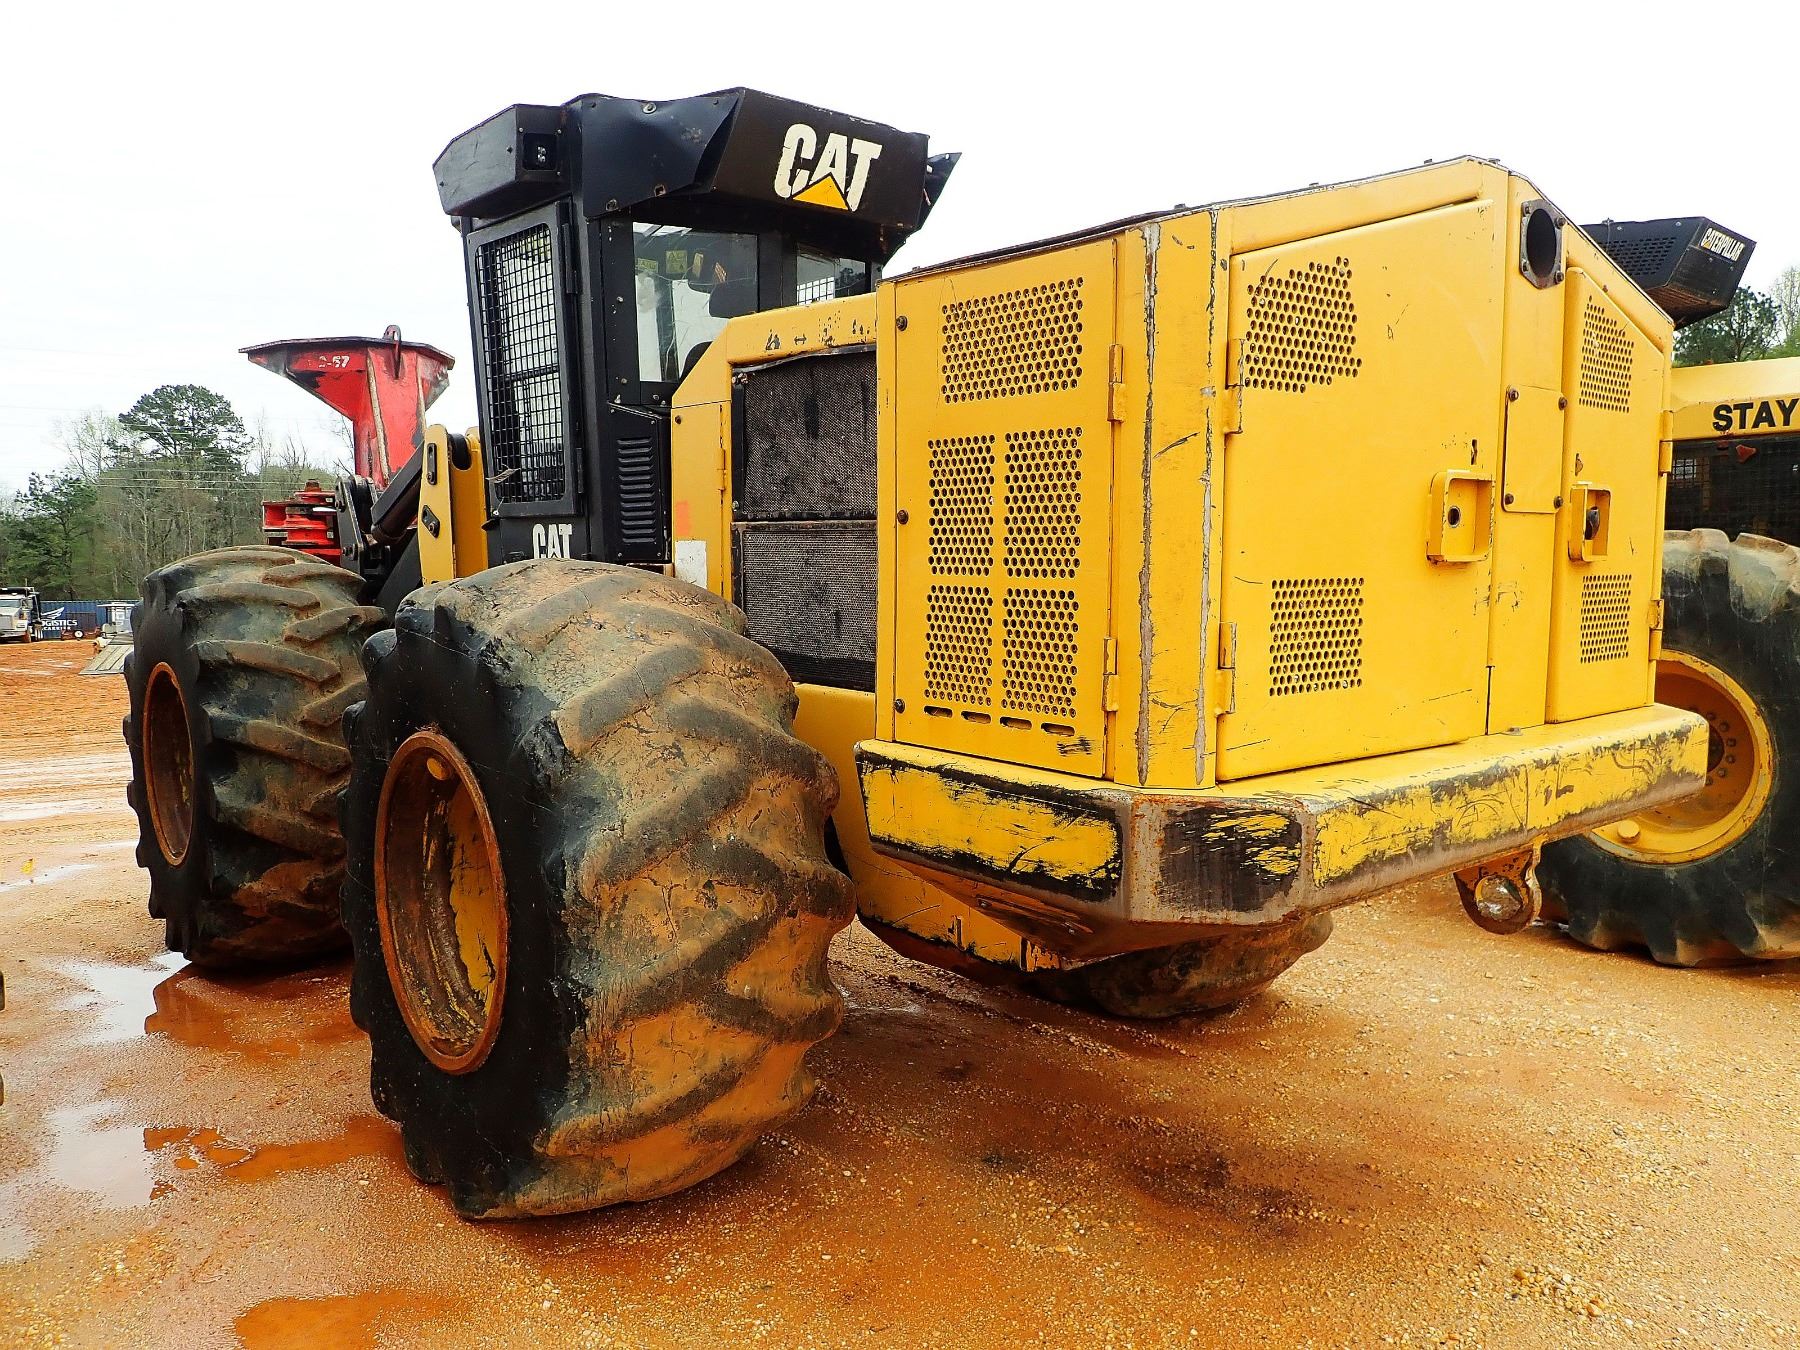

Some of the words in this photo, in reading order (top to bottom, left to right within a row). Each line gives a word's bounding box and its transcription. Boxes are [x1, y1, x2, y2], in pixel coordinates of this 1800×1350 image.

[774, 123, 882, 212] CAT
[1700, 227, 1745, 261] CATERPILLAR
[1712, 398, 1799, 431] STAY
[532, 523, 573, 559] CAT
